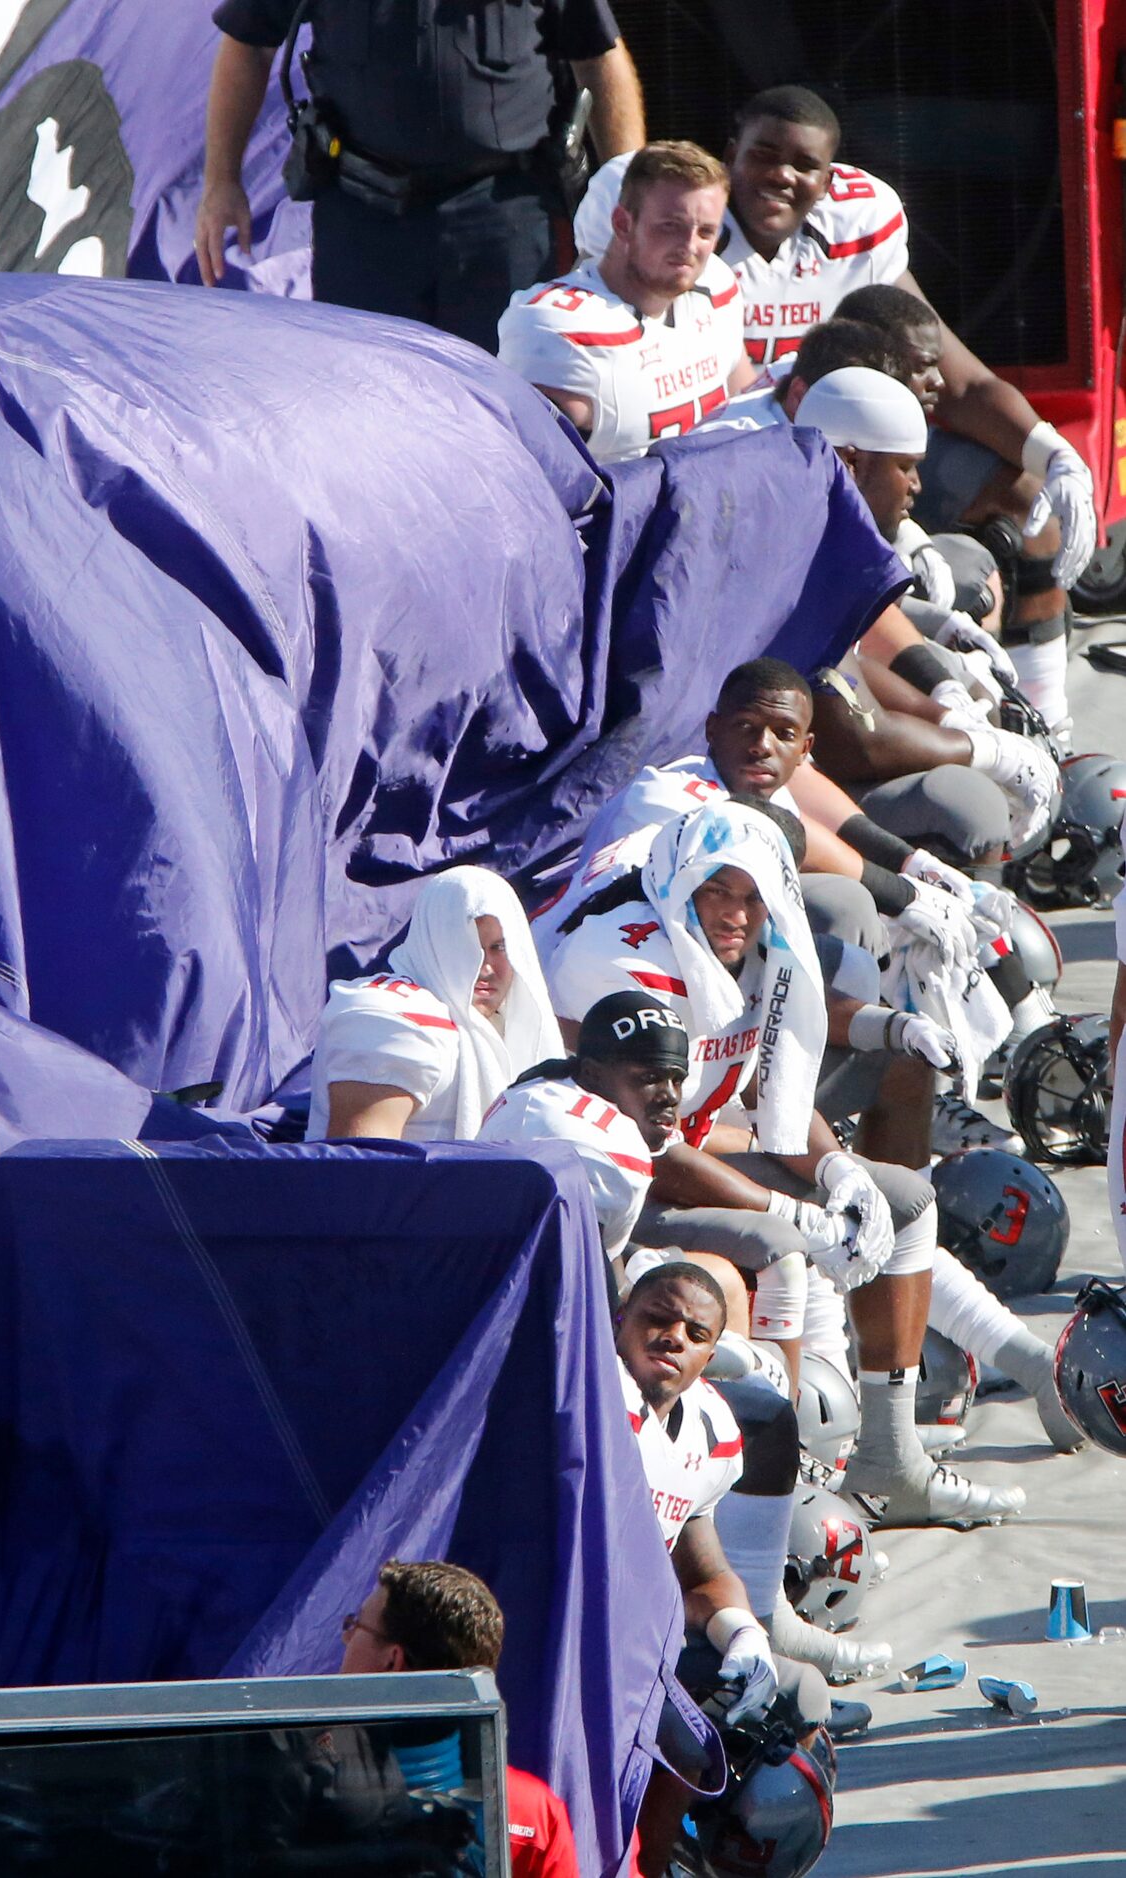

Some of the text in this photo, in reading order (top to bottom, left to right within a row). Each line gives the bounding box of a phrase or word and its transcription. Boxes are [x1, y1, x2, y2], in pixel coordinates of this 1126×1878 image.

[780, 301, 821, 326] TECH
[654, 366, 693, 399] TEXAS
[695, 353, 719, 384] TECH
[618, 920, 661, 950] 4
[612, 1009, 687, 1041] DRE
[694, 1027, 760, 1062] TEXAS TEC
[758, 966, 793, 1100] POWERADE
[565, 1094, 618, 1133] 11
[988, 1185, 1031, 1246] 3
[821, 1519, 862, 1585] 12
